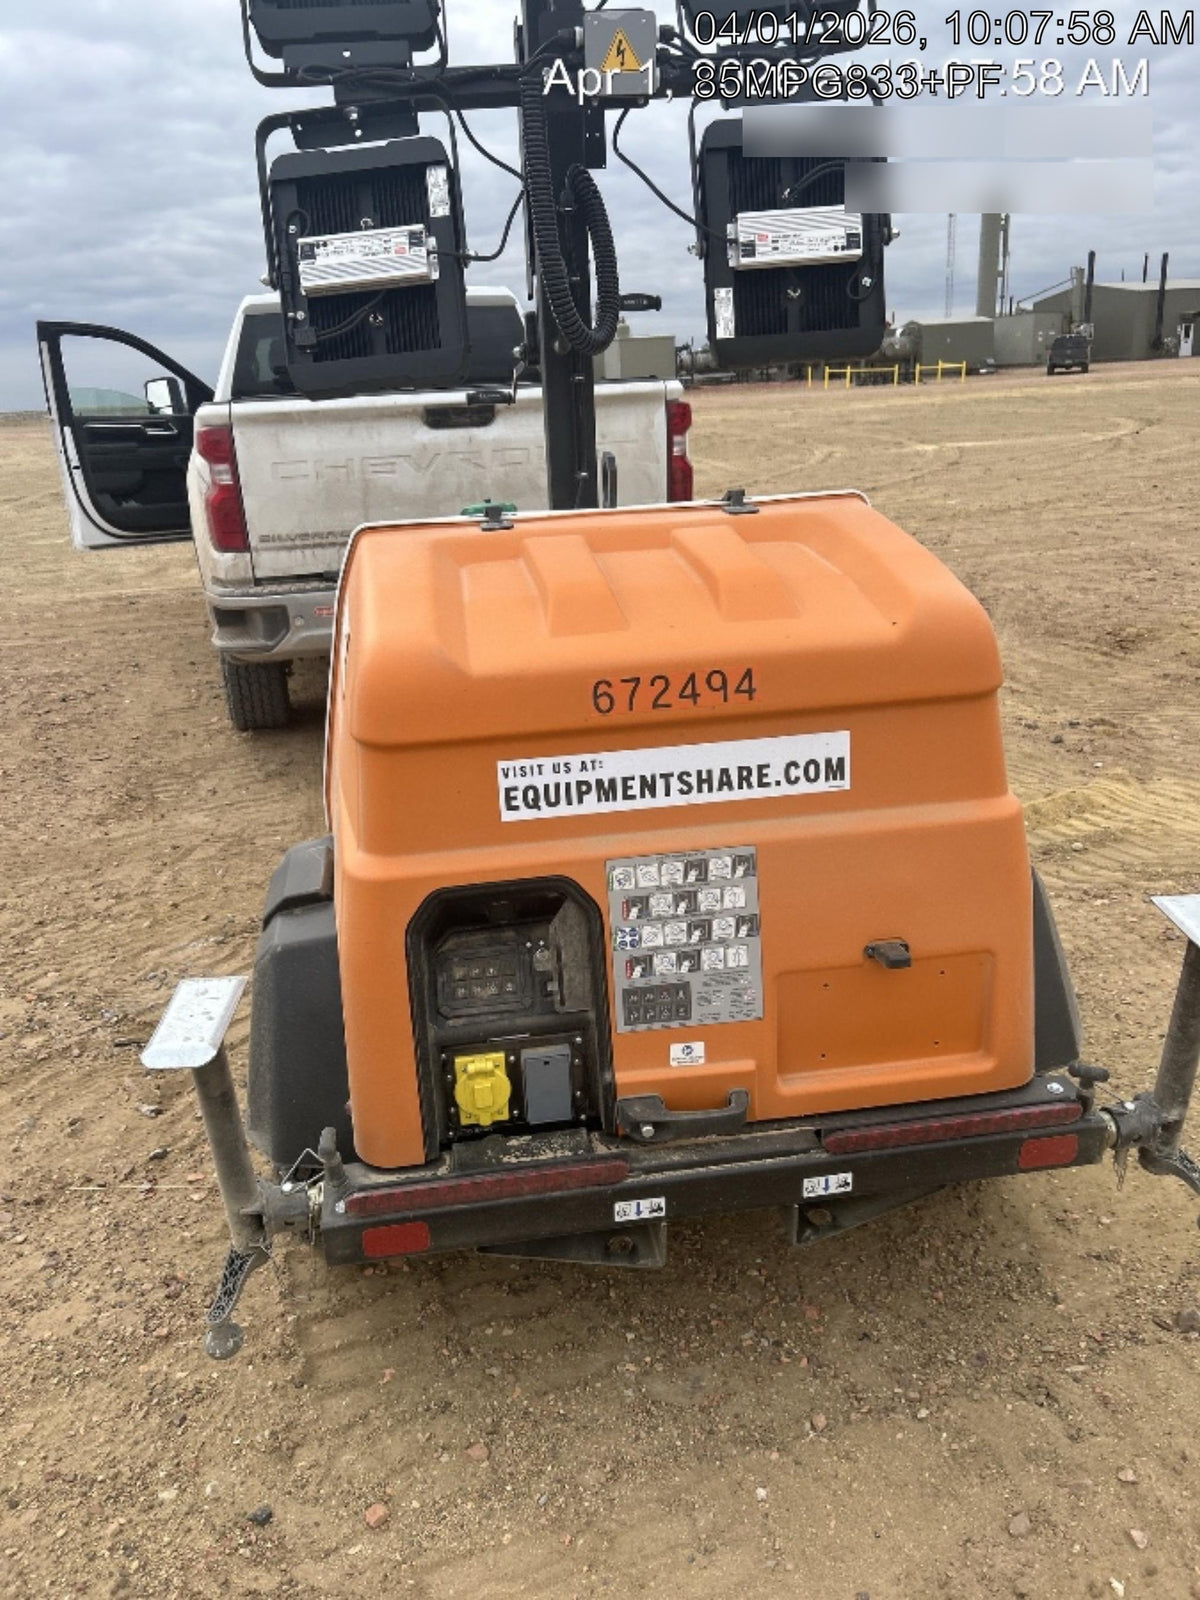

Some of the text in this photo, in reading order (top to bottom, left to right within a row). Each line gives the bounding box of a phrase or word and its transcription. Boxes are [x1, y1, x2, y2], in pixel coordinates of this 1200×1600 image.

[592, 667, 758, 715] 672494
[501, 759, 604, 779] VISIT US AT:
[503, 756, 846, 812] EQUIPMENTSHARE.COM
